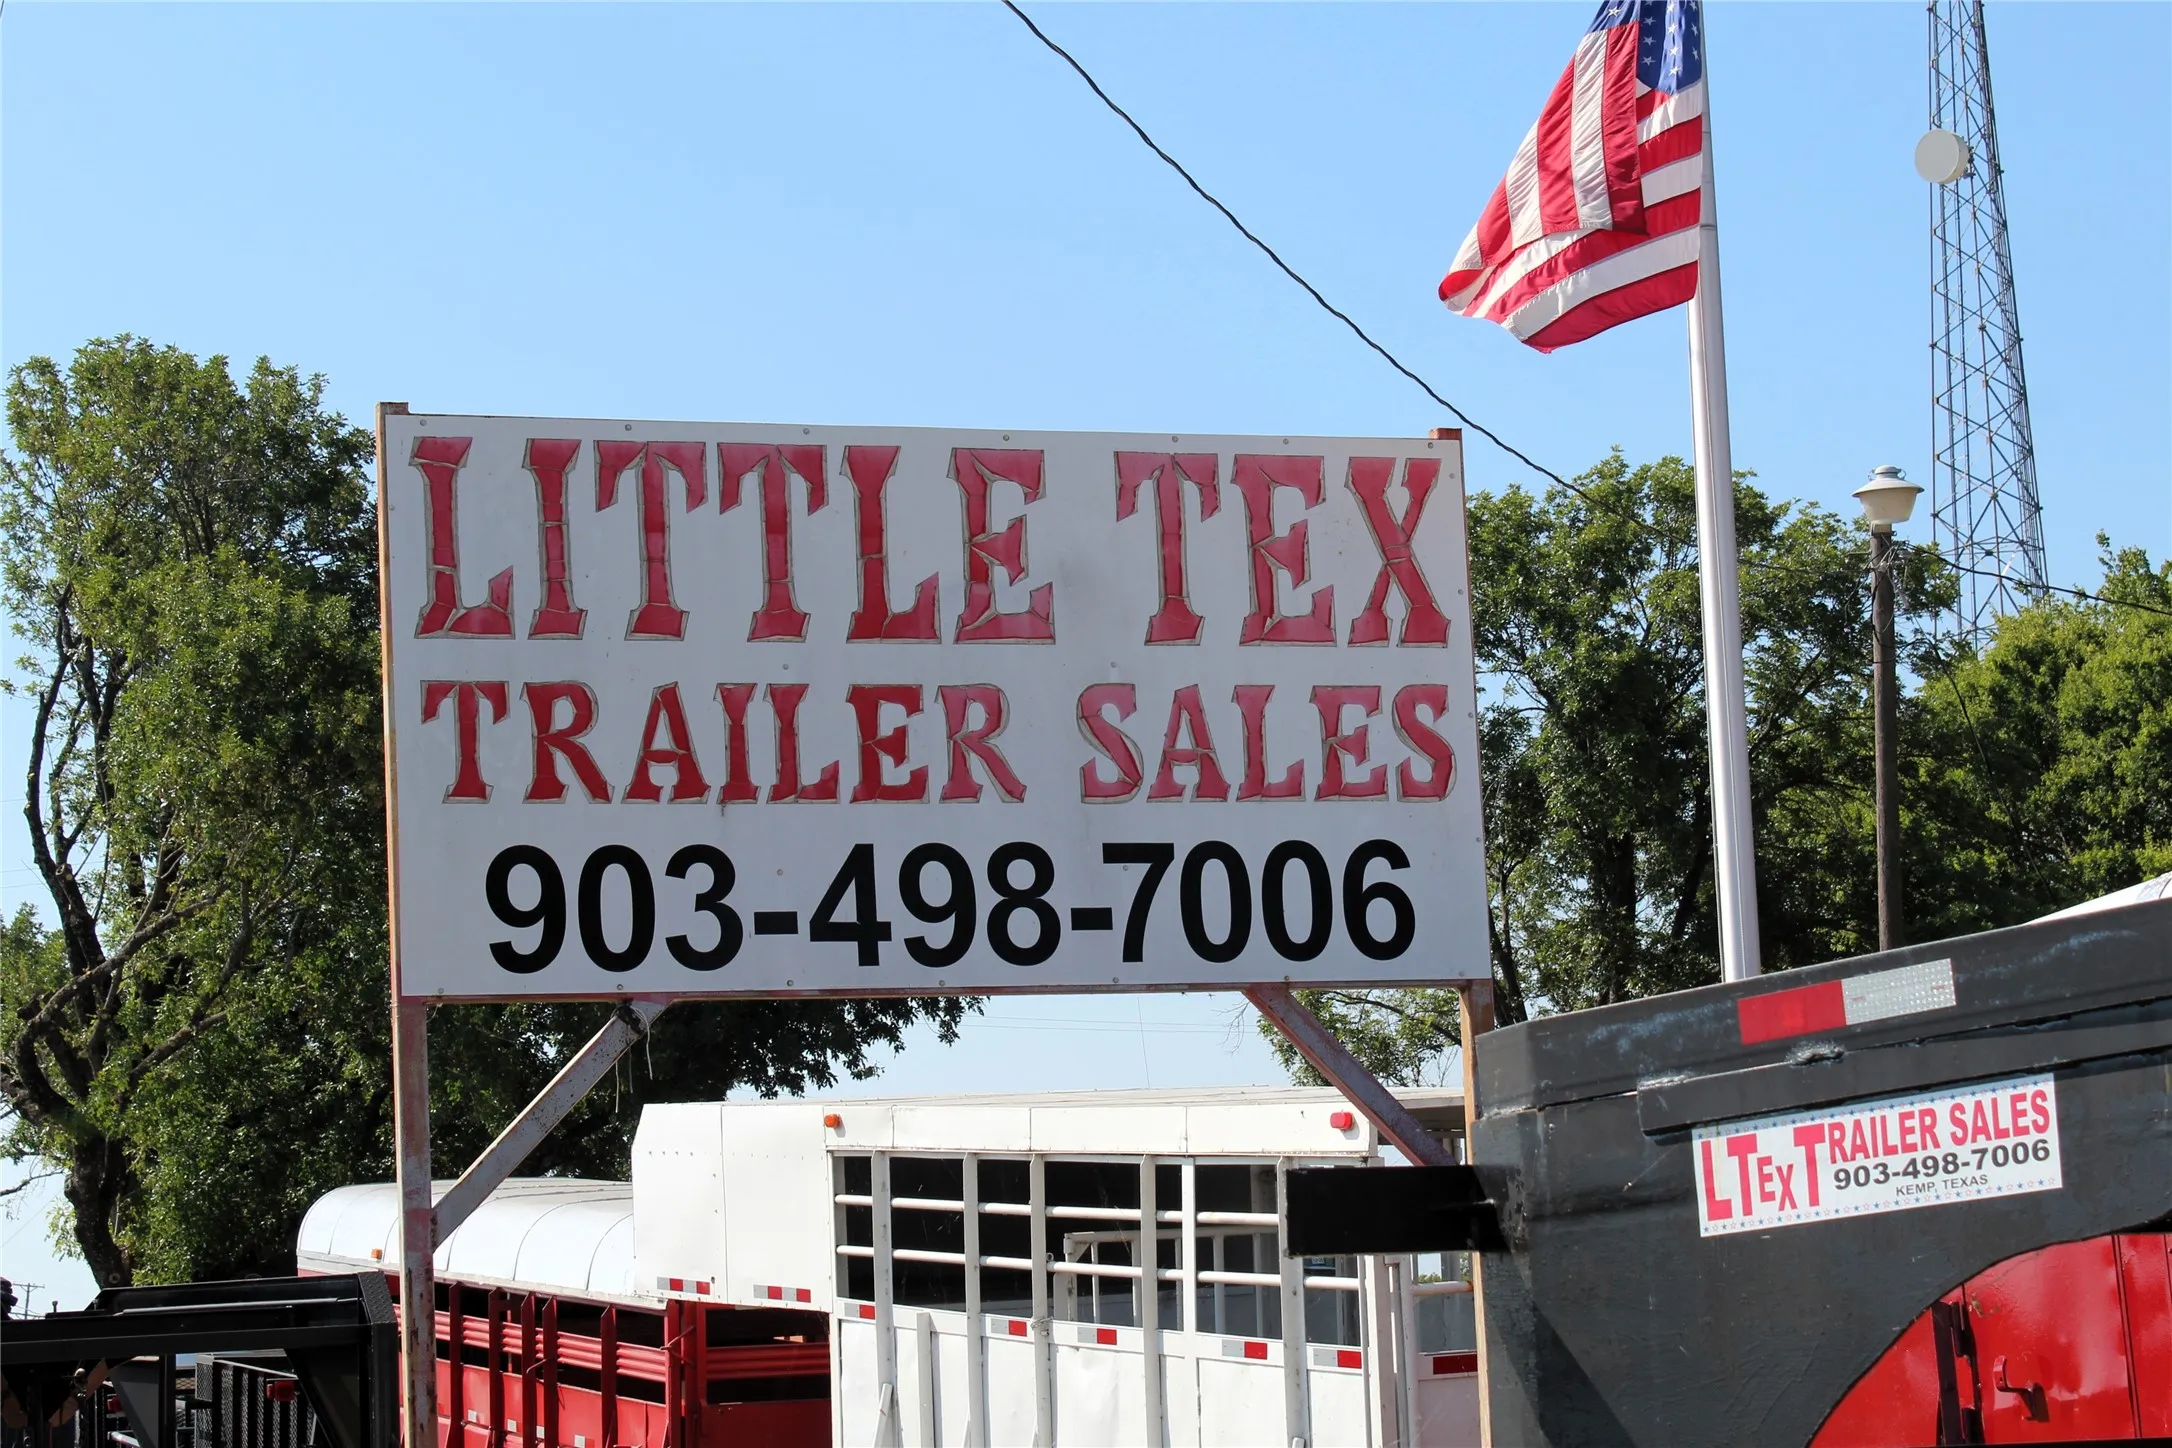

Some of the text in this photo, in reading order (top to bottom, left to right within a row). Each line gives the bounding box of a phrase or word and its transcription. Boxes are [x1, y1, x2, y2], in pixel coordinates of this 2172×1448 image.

[409, 436, 1451, 648] LITTLE TEX
[420, 680, 1457, 804] TRAILER SALES
[485, 839, 1416, 974] 903-498-7006
[1949, 1089, 2050, 1146] SALES
[1833, 1139, 2050, 1190] 903-498-7006
[1942, 1174, 1988, 1190] TEXAS
